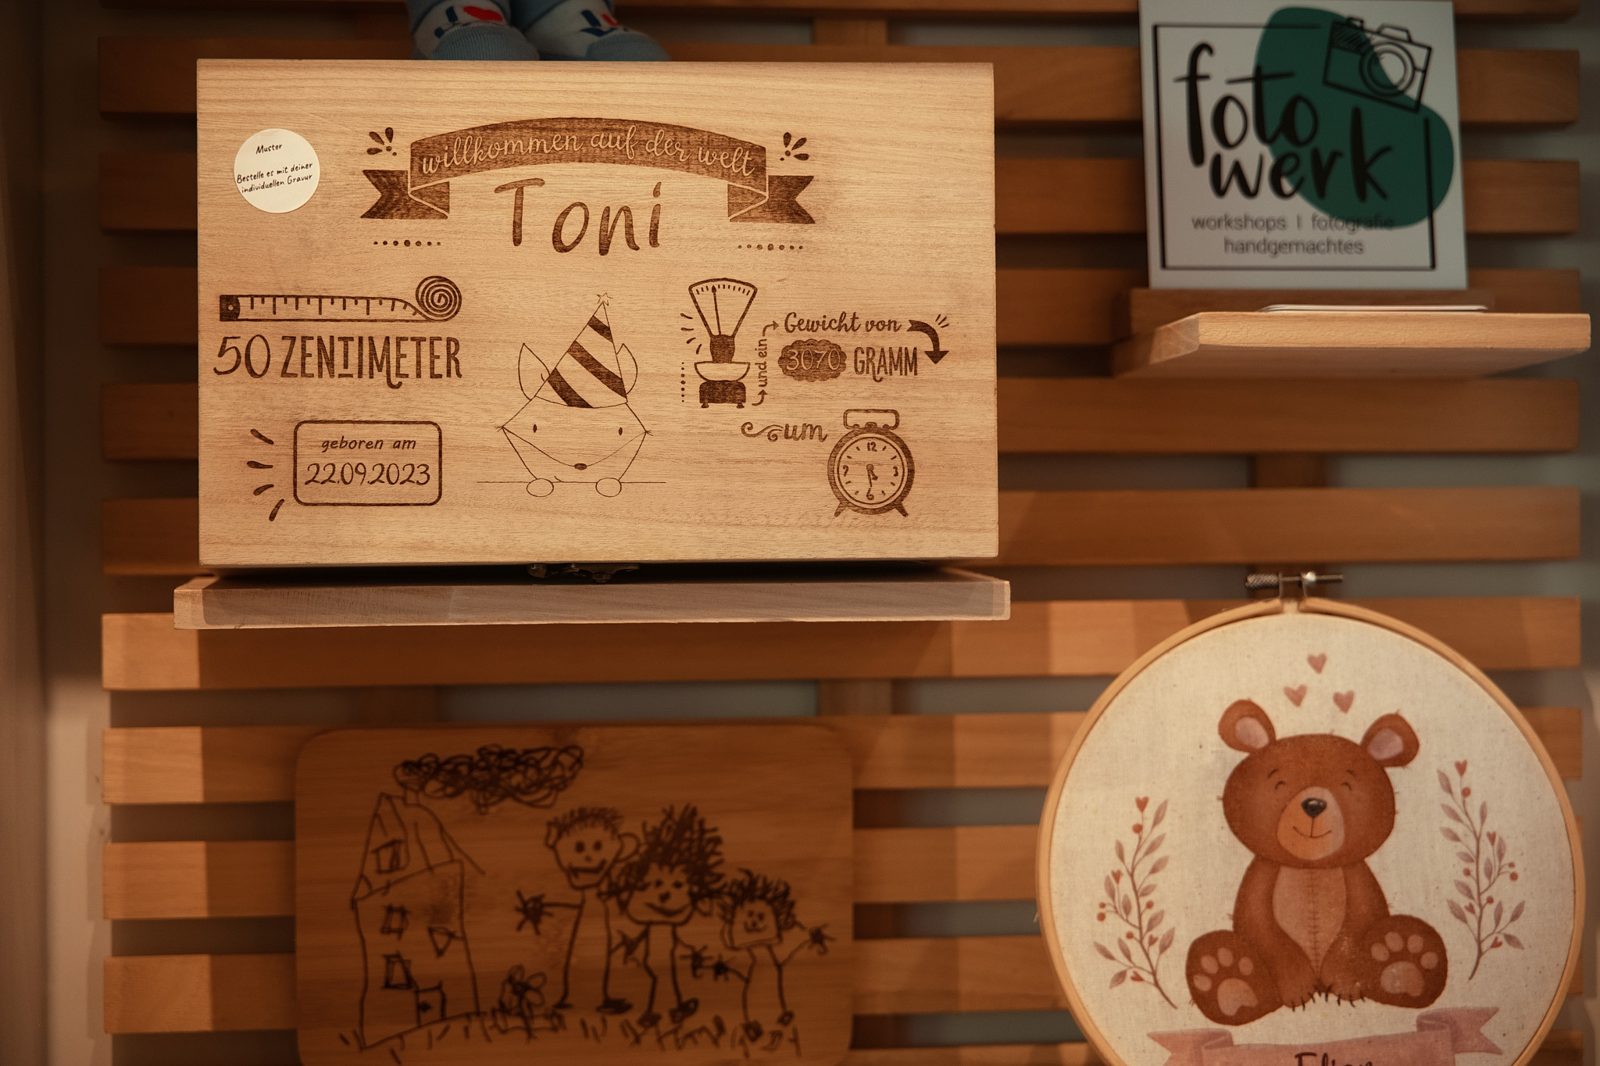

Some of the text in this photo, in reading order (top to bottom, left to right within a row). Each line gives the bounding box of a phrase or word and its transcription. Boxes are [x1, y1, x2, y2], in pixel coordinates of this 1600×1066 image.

[1173, 41, 1318, 167] foto
[255, 144, 283, 155] Muster
[421, 125, 755, 177] willkommen auf der welt
[1209, 106, 1393, 203] werk
[236, 170, 264, 184] Bestelle
[276, 166, 289, 175] mit
[290, 162, 313, 173] deiner
[241, 174, 313, 193] individuellen Gravur
[494, 178, 663, 256] Toni
[1191, 213, 1287, 231] workshops
[1310, 213, 1394, 234] fotografie
[1223, 237, 1365, 258] handgemachtes
[784, 311, 902, 333] Gewicht von
[213, 334, 462, 389] 50 ZENTIMETER
[754, 338, 768, 388] und ein
[785, 346, 918, 382] 3070 GRAMM
[783, 422, 828, 442] um
[321, 436, 416, 453] geboren am
[867, 441, 878, 452] 12
[304, 462, 431, 486] 22.09.2023
[893, 465, 899, 477] 3
[866, 487, 875, 500] 6
